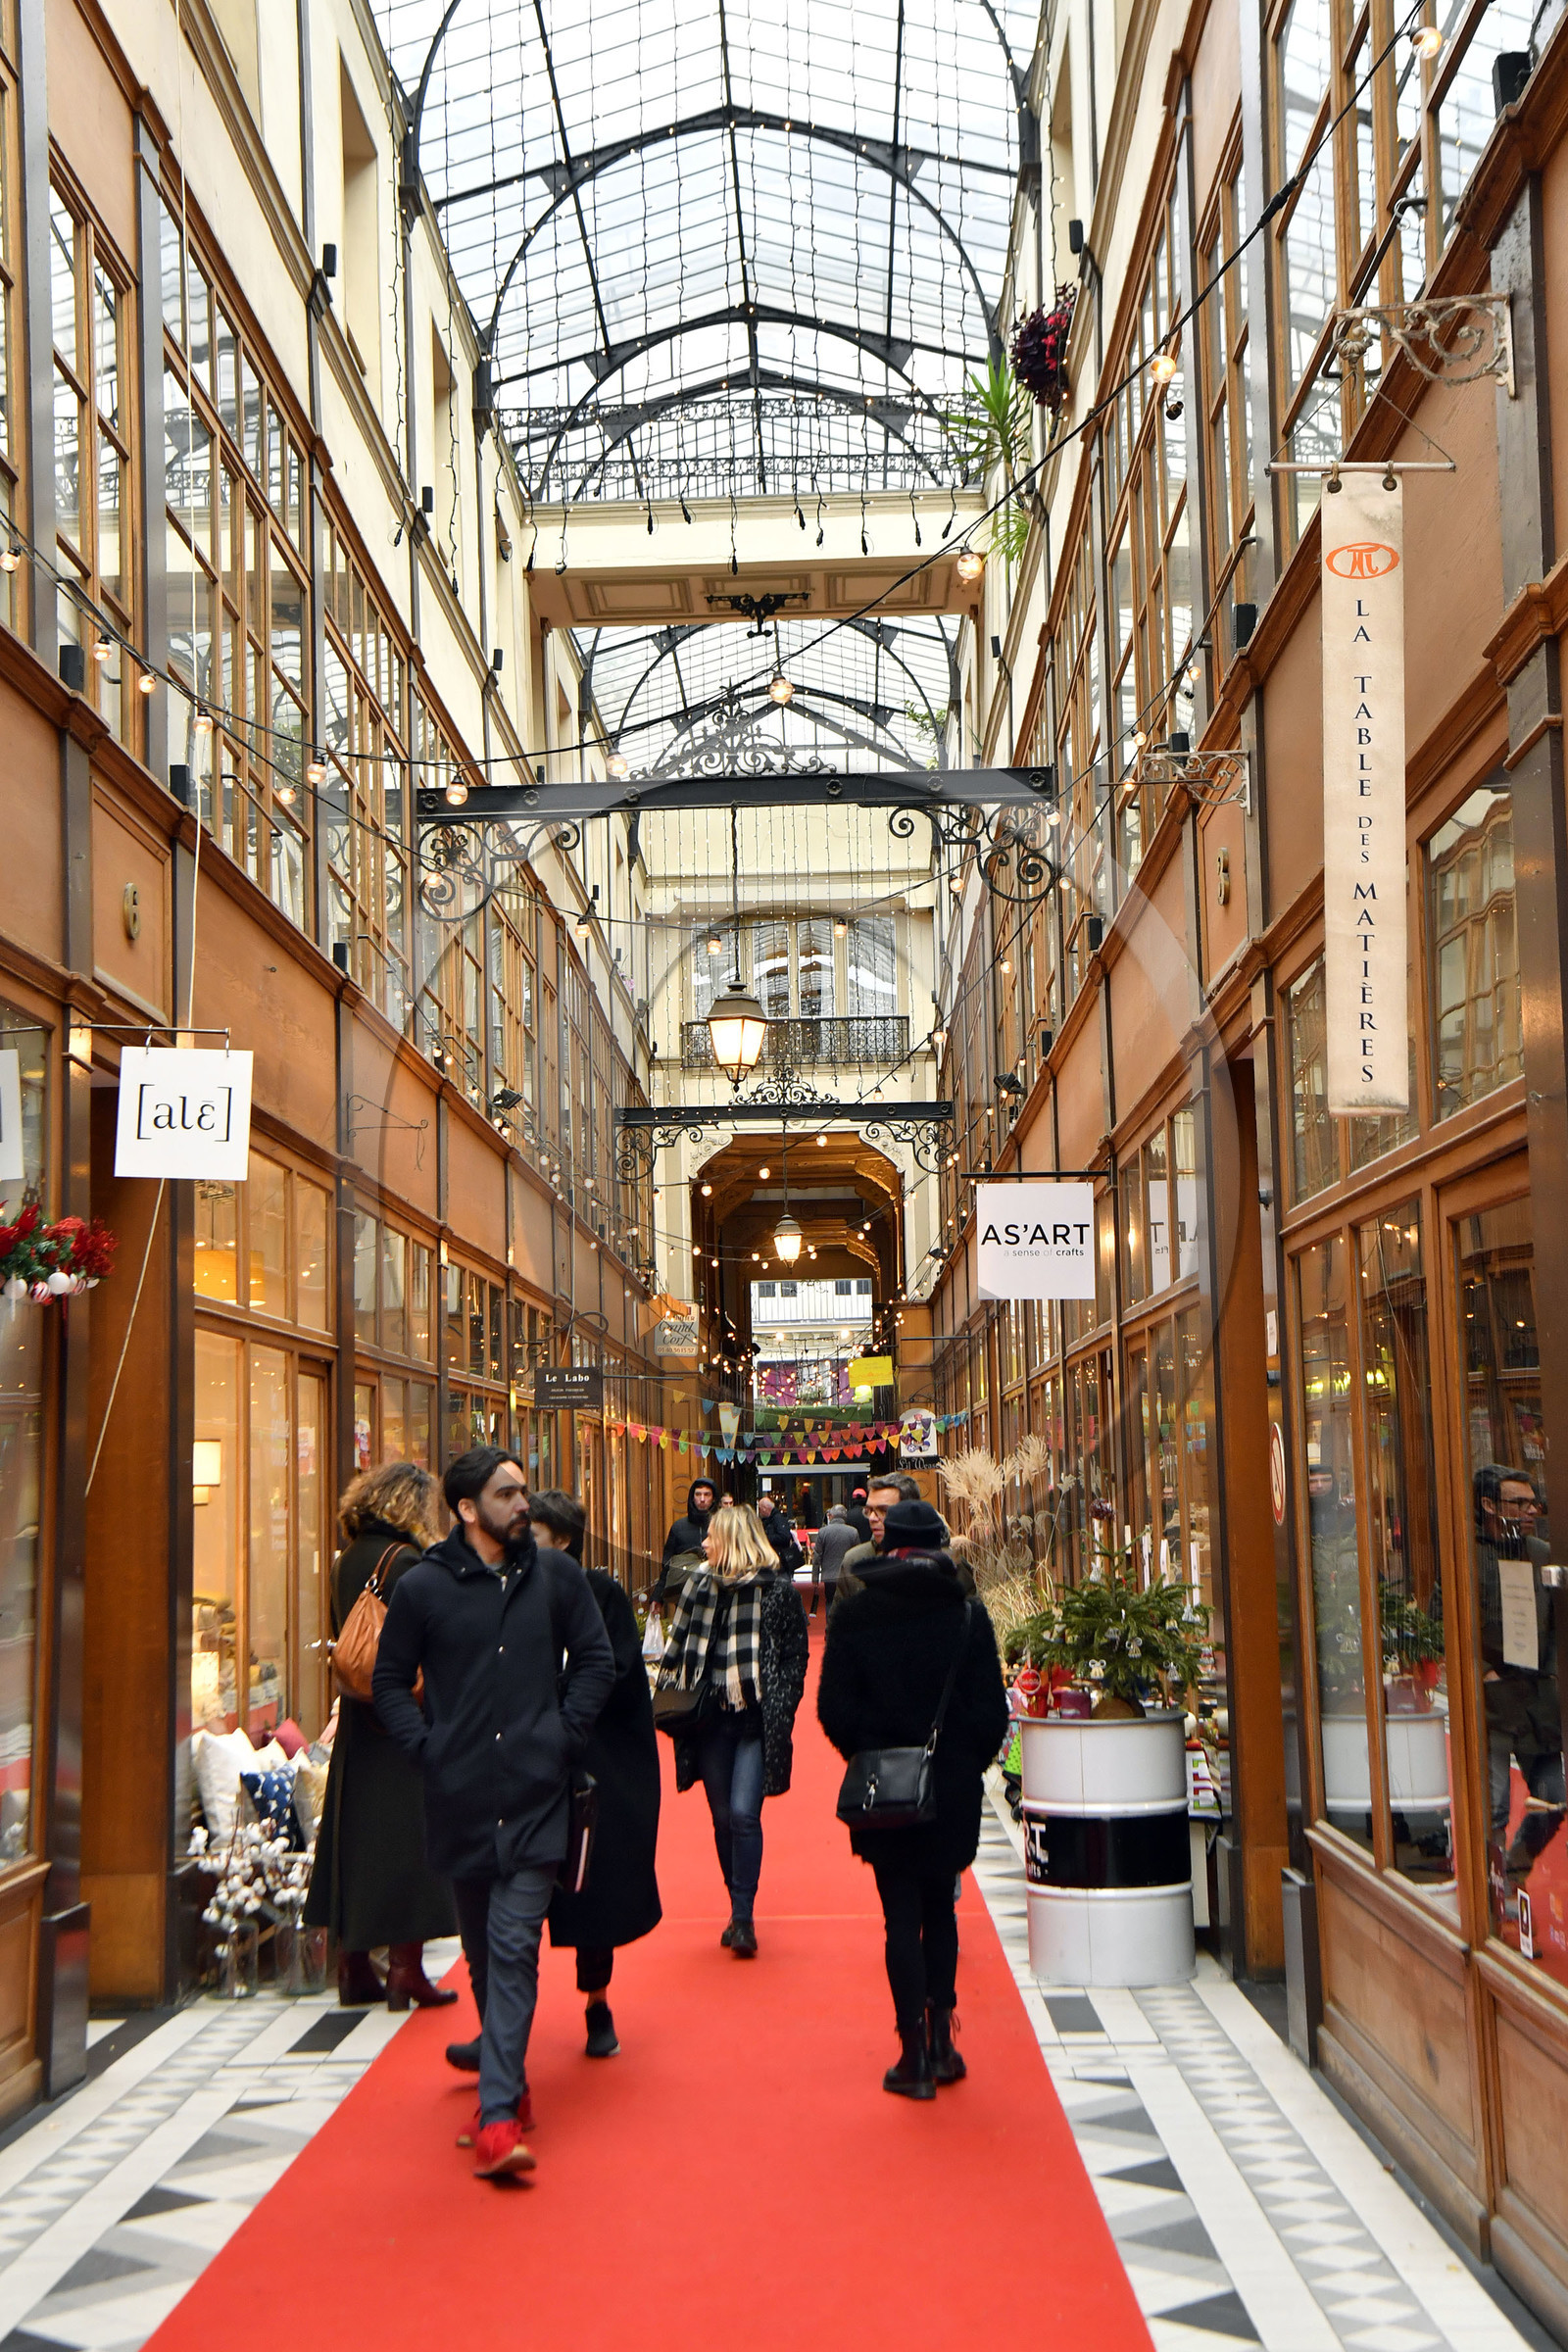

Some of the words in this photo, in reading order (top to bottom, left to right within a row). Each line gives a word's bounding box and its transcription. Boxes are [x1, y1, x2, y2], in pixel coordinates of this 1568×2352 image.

[1353, 600, 1371, 643] LA
[1353, 676, 1373, 797] TABLE
[1358, 816, 1373, 863] DES
[1353, 882, 1377, 1083] MATIÈRES
[981, 1223, 1091, 1246] AS'ART
[1043, 1248, 1053, 1256] of
[1055, 1248, 1084, 1256] crafts
[662, 1333, 691, 1346] Cerf
[545, 1373, 558, 1383] Le
[564, 1373, 590, 1383] Labo
[911, 1457, 941, 1470] Wease
